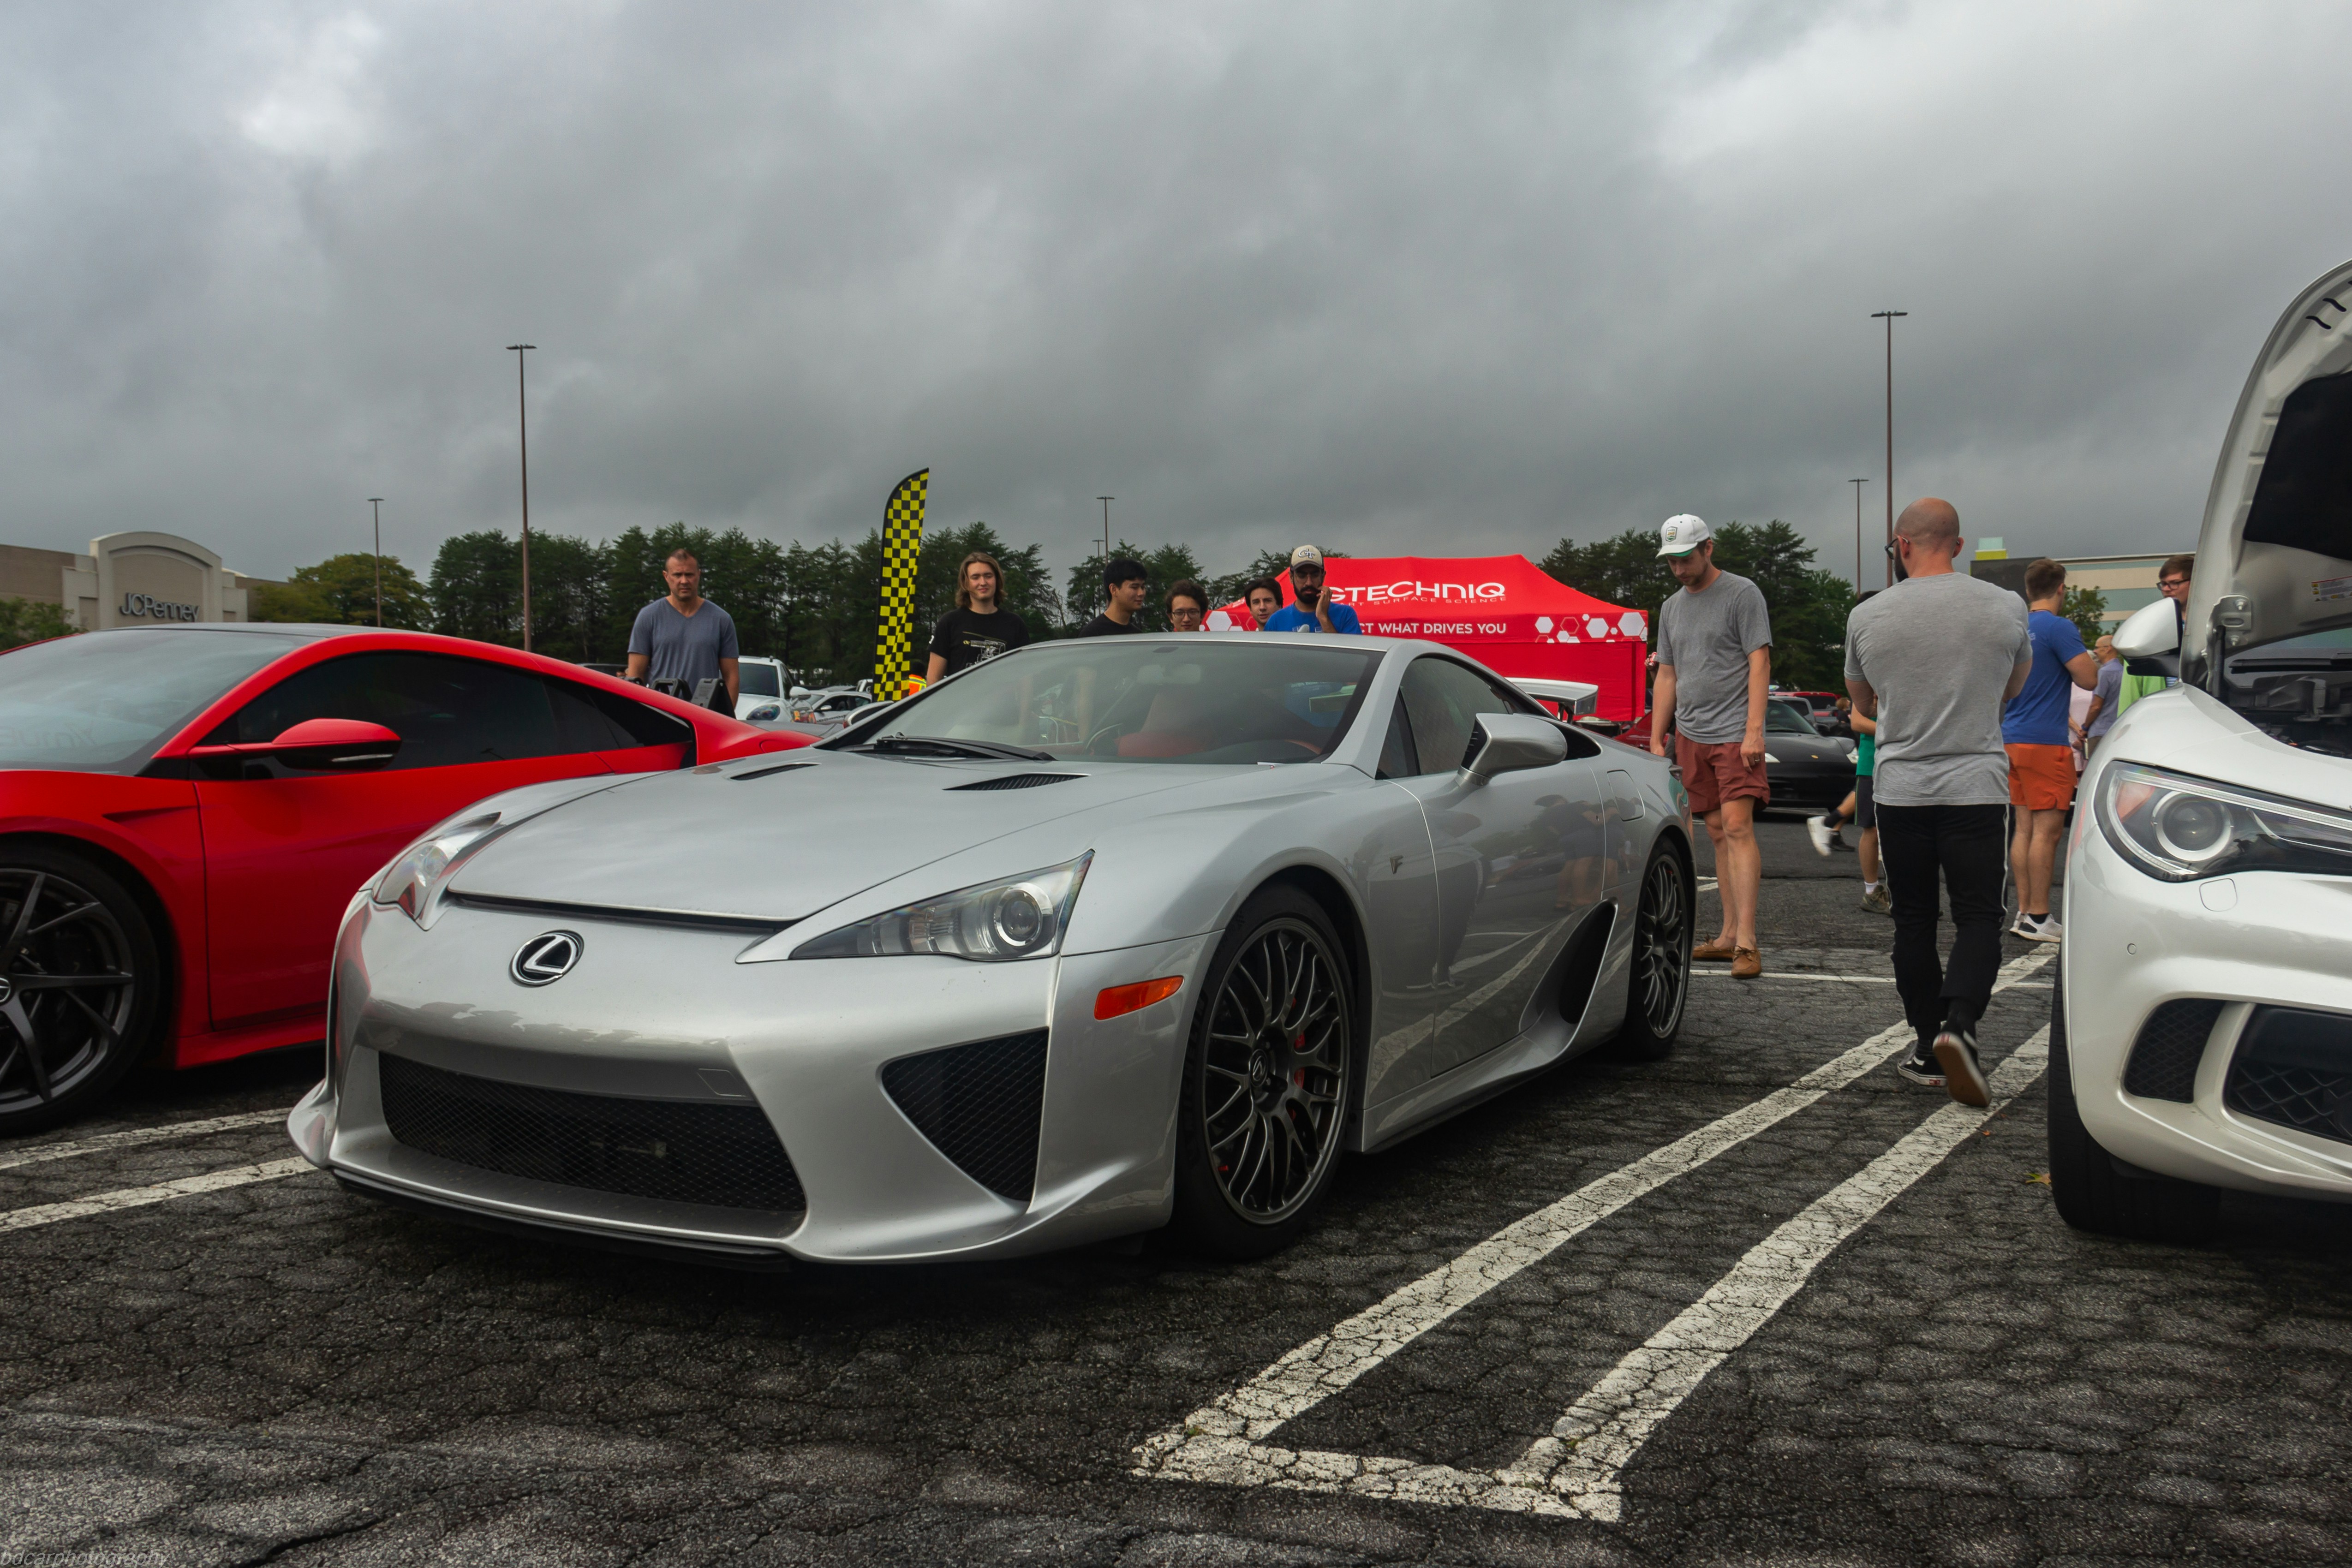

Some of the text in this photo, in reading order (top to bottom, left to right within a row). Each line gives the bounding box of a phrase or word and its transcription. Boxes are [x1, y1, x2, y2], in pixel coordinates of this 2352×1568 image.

[1373, 596, 1436, 606] SURFACE
[119, 593, 200, 622] JCPenney
[1378, 623, 1420, 633] WHAT
[1424, 623, 1473, 634] DRIVES
[1477, 623, 1506, 634] YOU
